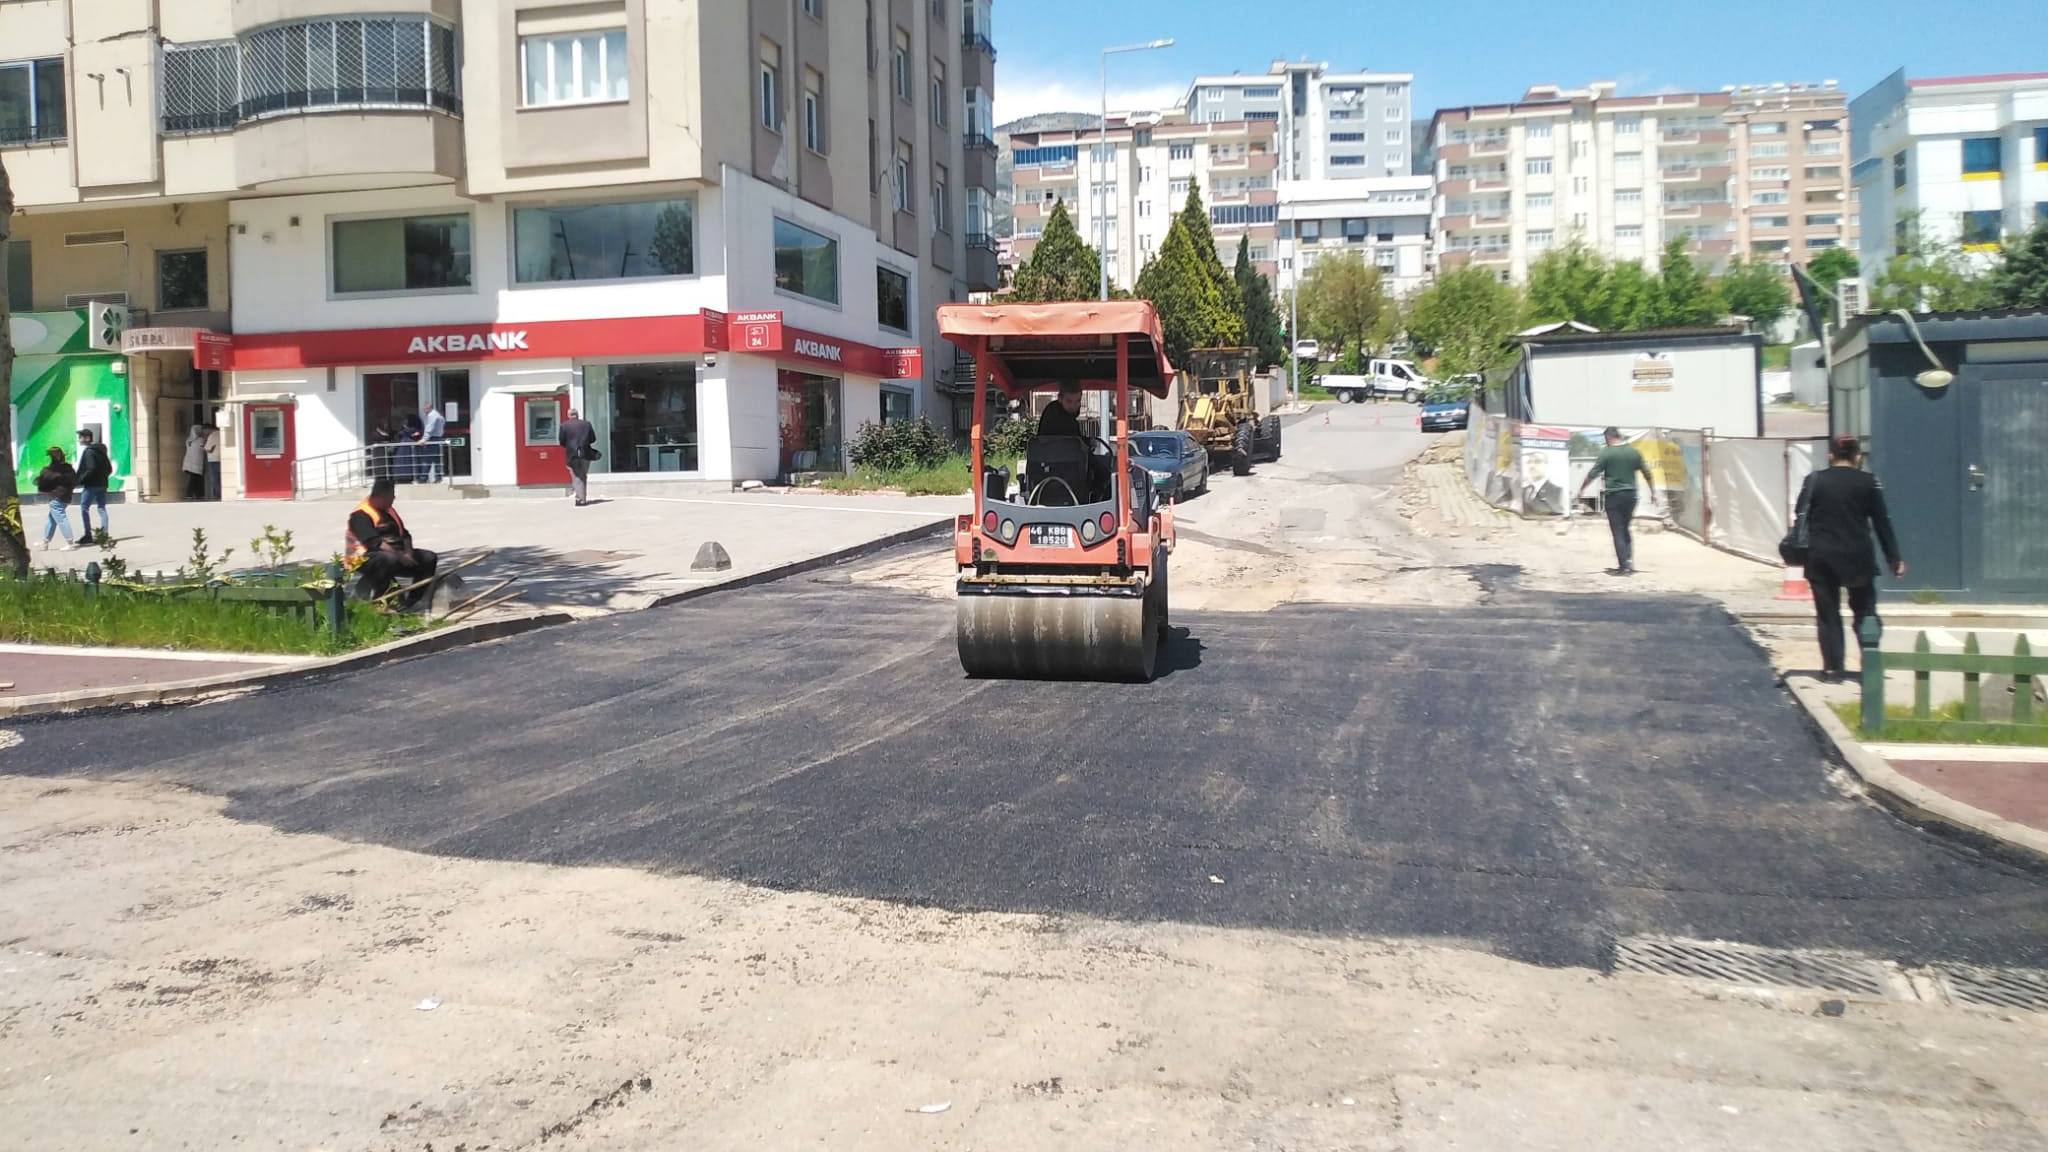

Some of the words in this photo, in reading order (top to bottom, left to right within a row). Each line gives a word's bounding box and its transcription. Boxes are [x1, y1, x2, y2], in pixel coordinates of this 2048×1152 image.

[736, 313, 776, 321] AKBANK
[408, 331, 528, 353] AKBANK
[752, 337, 762, 346] 24
[794, 339, 842, 361] AKBANK
[1030, 526, 1043, 536] 46
